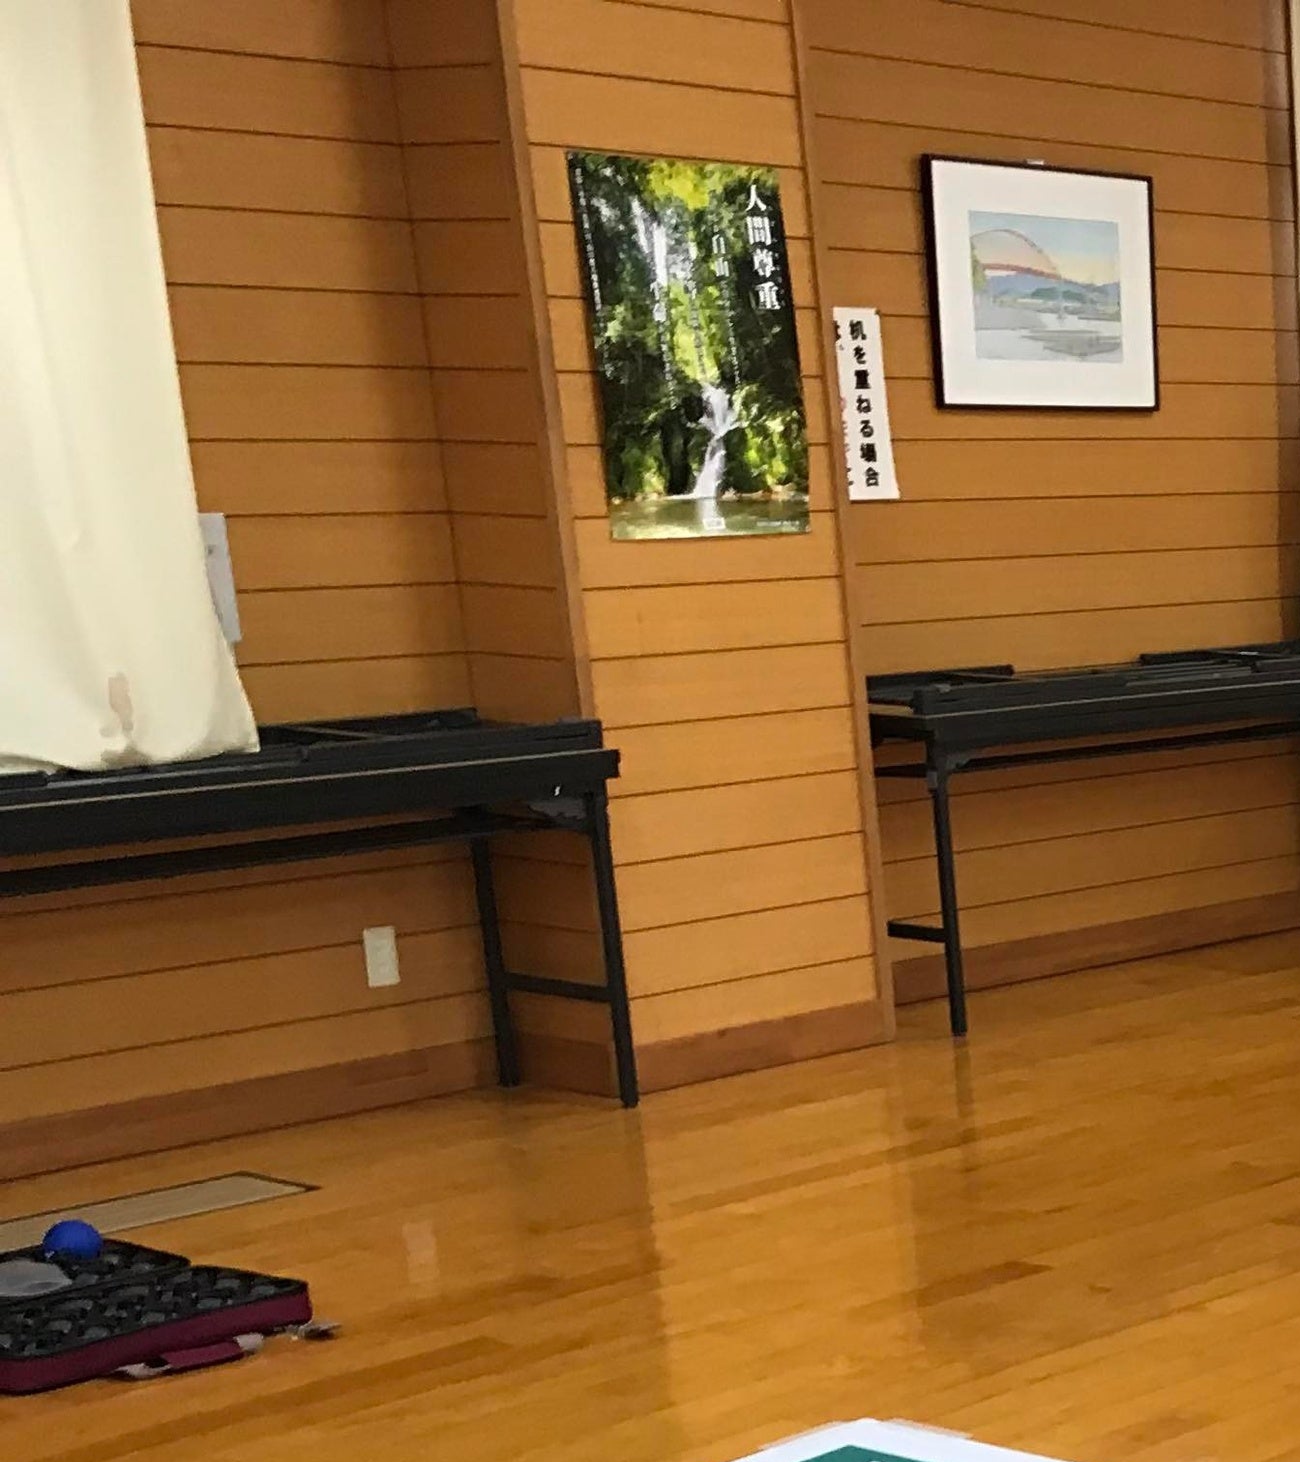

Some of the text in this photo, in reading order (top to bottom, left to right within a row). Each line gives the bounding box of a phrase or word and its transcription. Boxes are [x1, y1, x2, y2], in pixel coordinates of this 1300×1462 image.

[745, 183, 781, 310] 人間尊重
[849, 320, 880, 488] 机を重ねる場合
